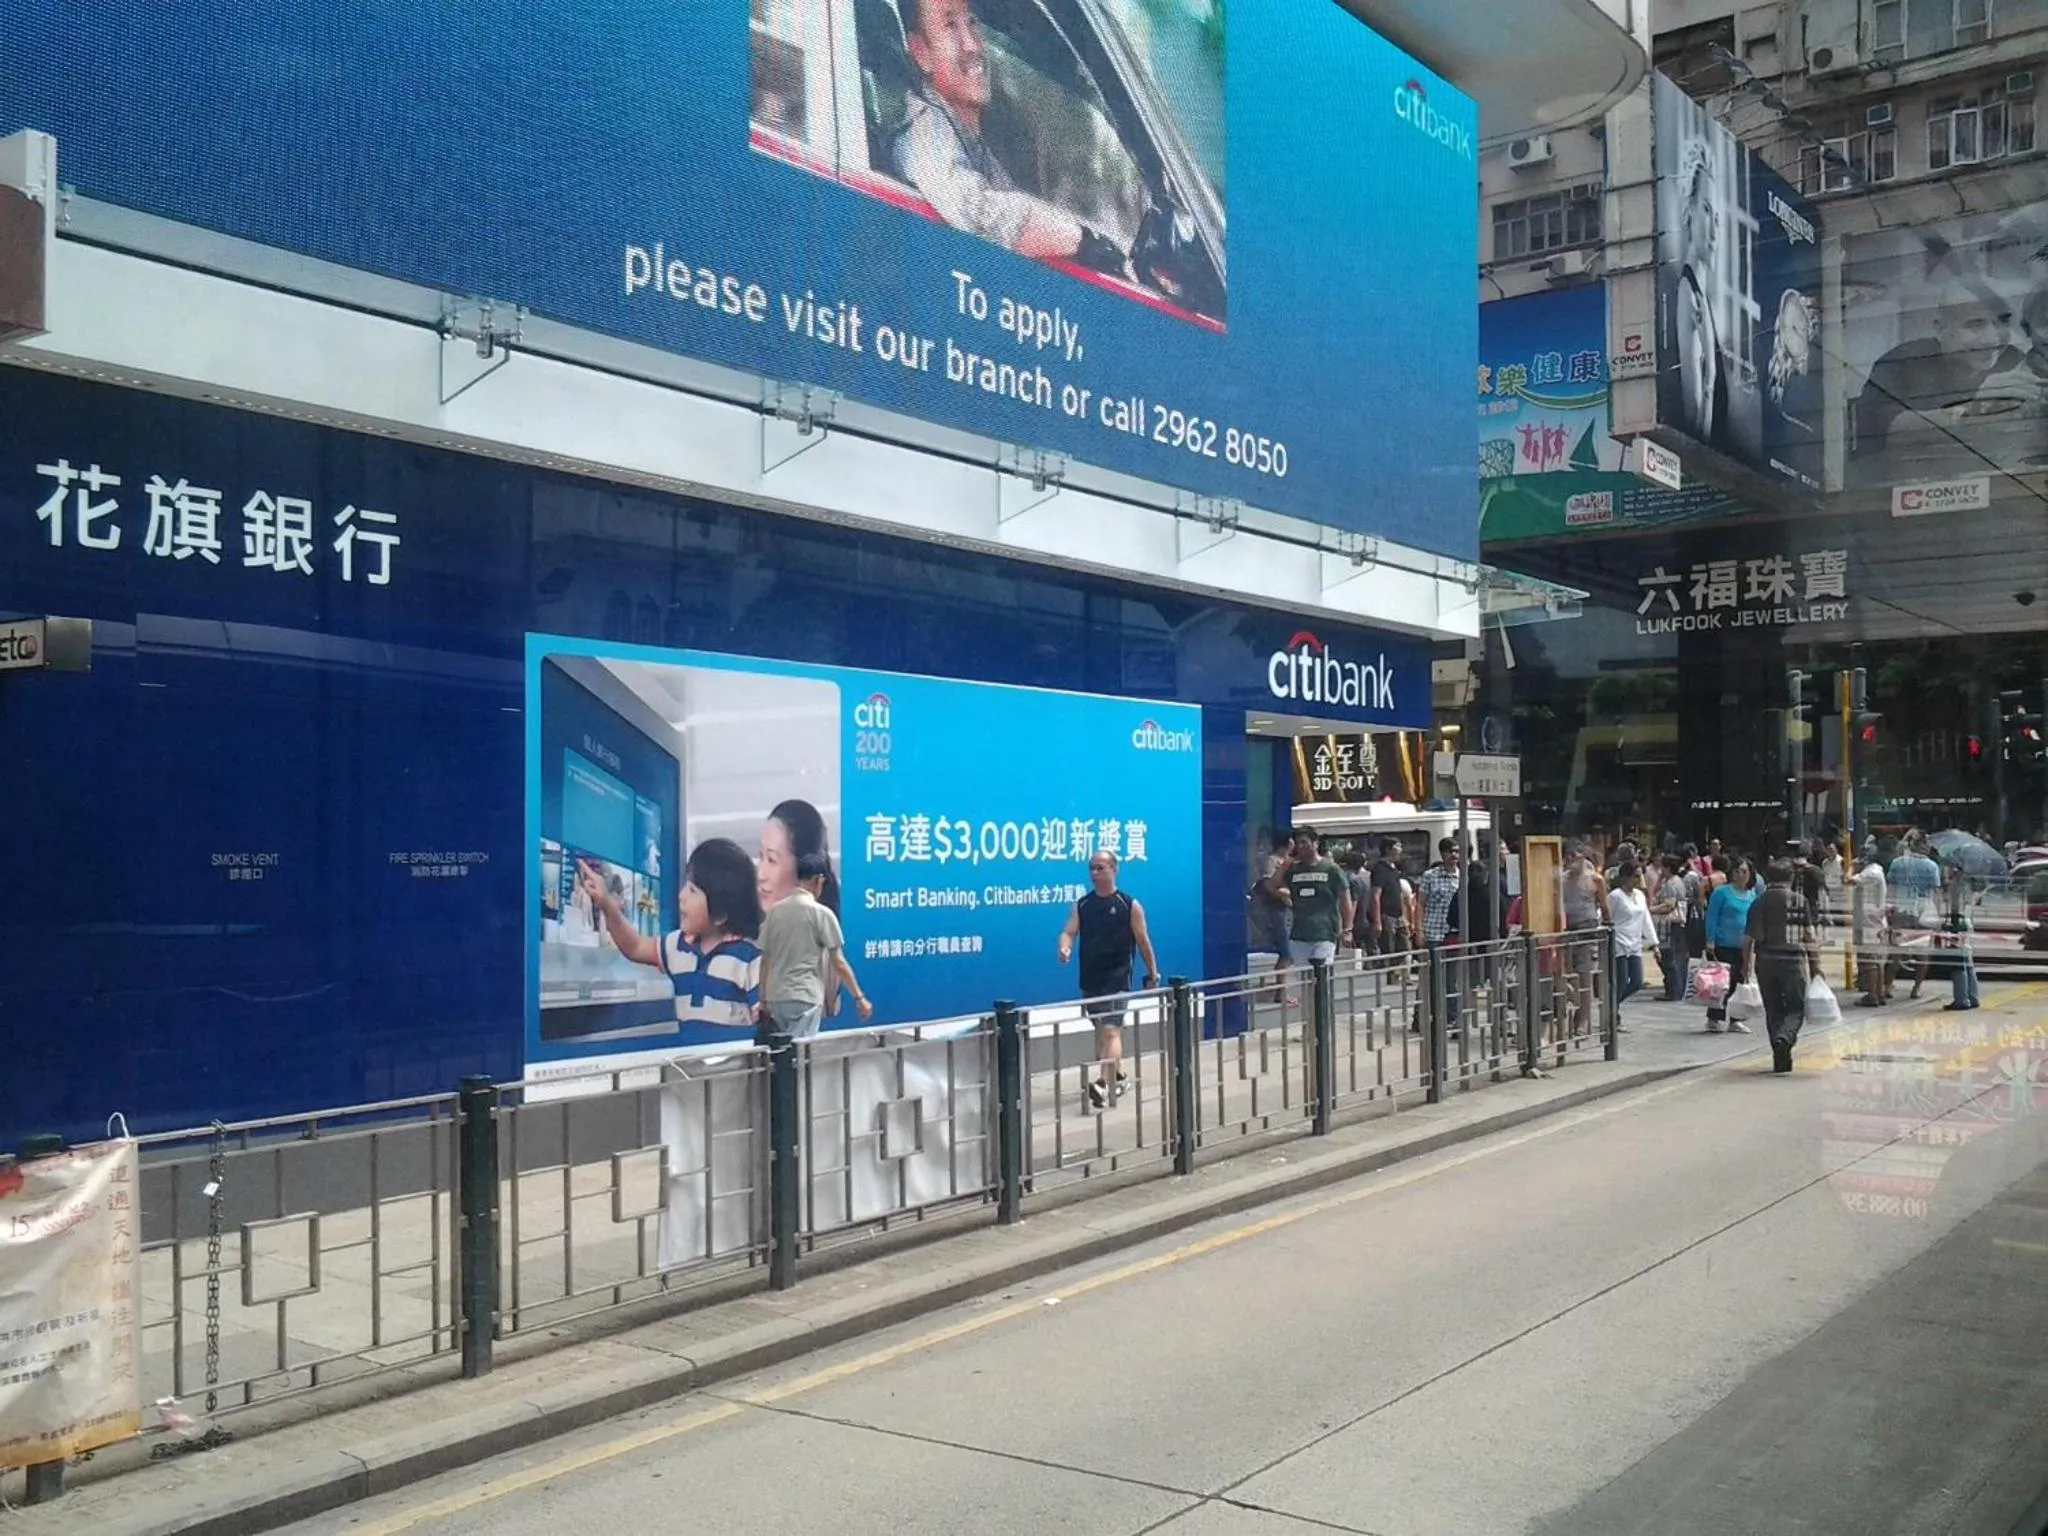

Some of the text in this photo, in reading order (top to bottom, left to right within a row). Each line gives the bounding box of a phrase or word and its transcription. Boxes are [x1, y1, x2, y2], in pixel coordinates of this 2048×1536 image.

[1394, 84, 1472, 161] citibank
[951, 268, 1084, 363] To apply,
[624, 241, 1288, 478] please visit our branch or call 2962 8050
[1611, 352, 1654, 367] CONVEY
[1925, 484, 1979, 499] CONVEY
[36, 458, 401, 586] 花旗銀行
[1636, 549, 1849, 615] 六福珠寶
[1635, 602, 1850, 636] LUKFOOK JEWELLERY
[1267, 644, 1396, 711] citibank
[854, 701, 890, 729] citi
[855, 731, 892, 754] 200
[1131, 722, 1194, 752] citibank
[855, 757, 891, 772] YEARS
[864, 811, 1148, 865] 高達$3,000迎新獎賞
[211, 853, 280, 866] SMOKE VENT
[864, 887, 913, 909] Smart
[917, 885, 981, 911] Banking.
